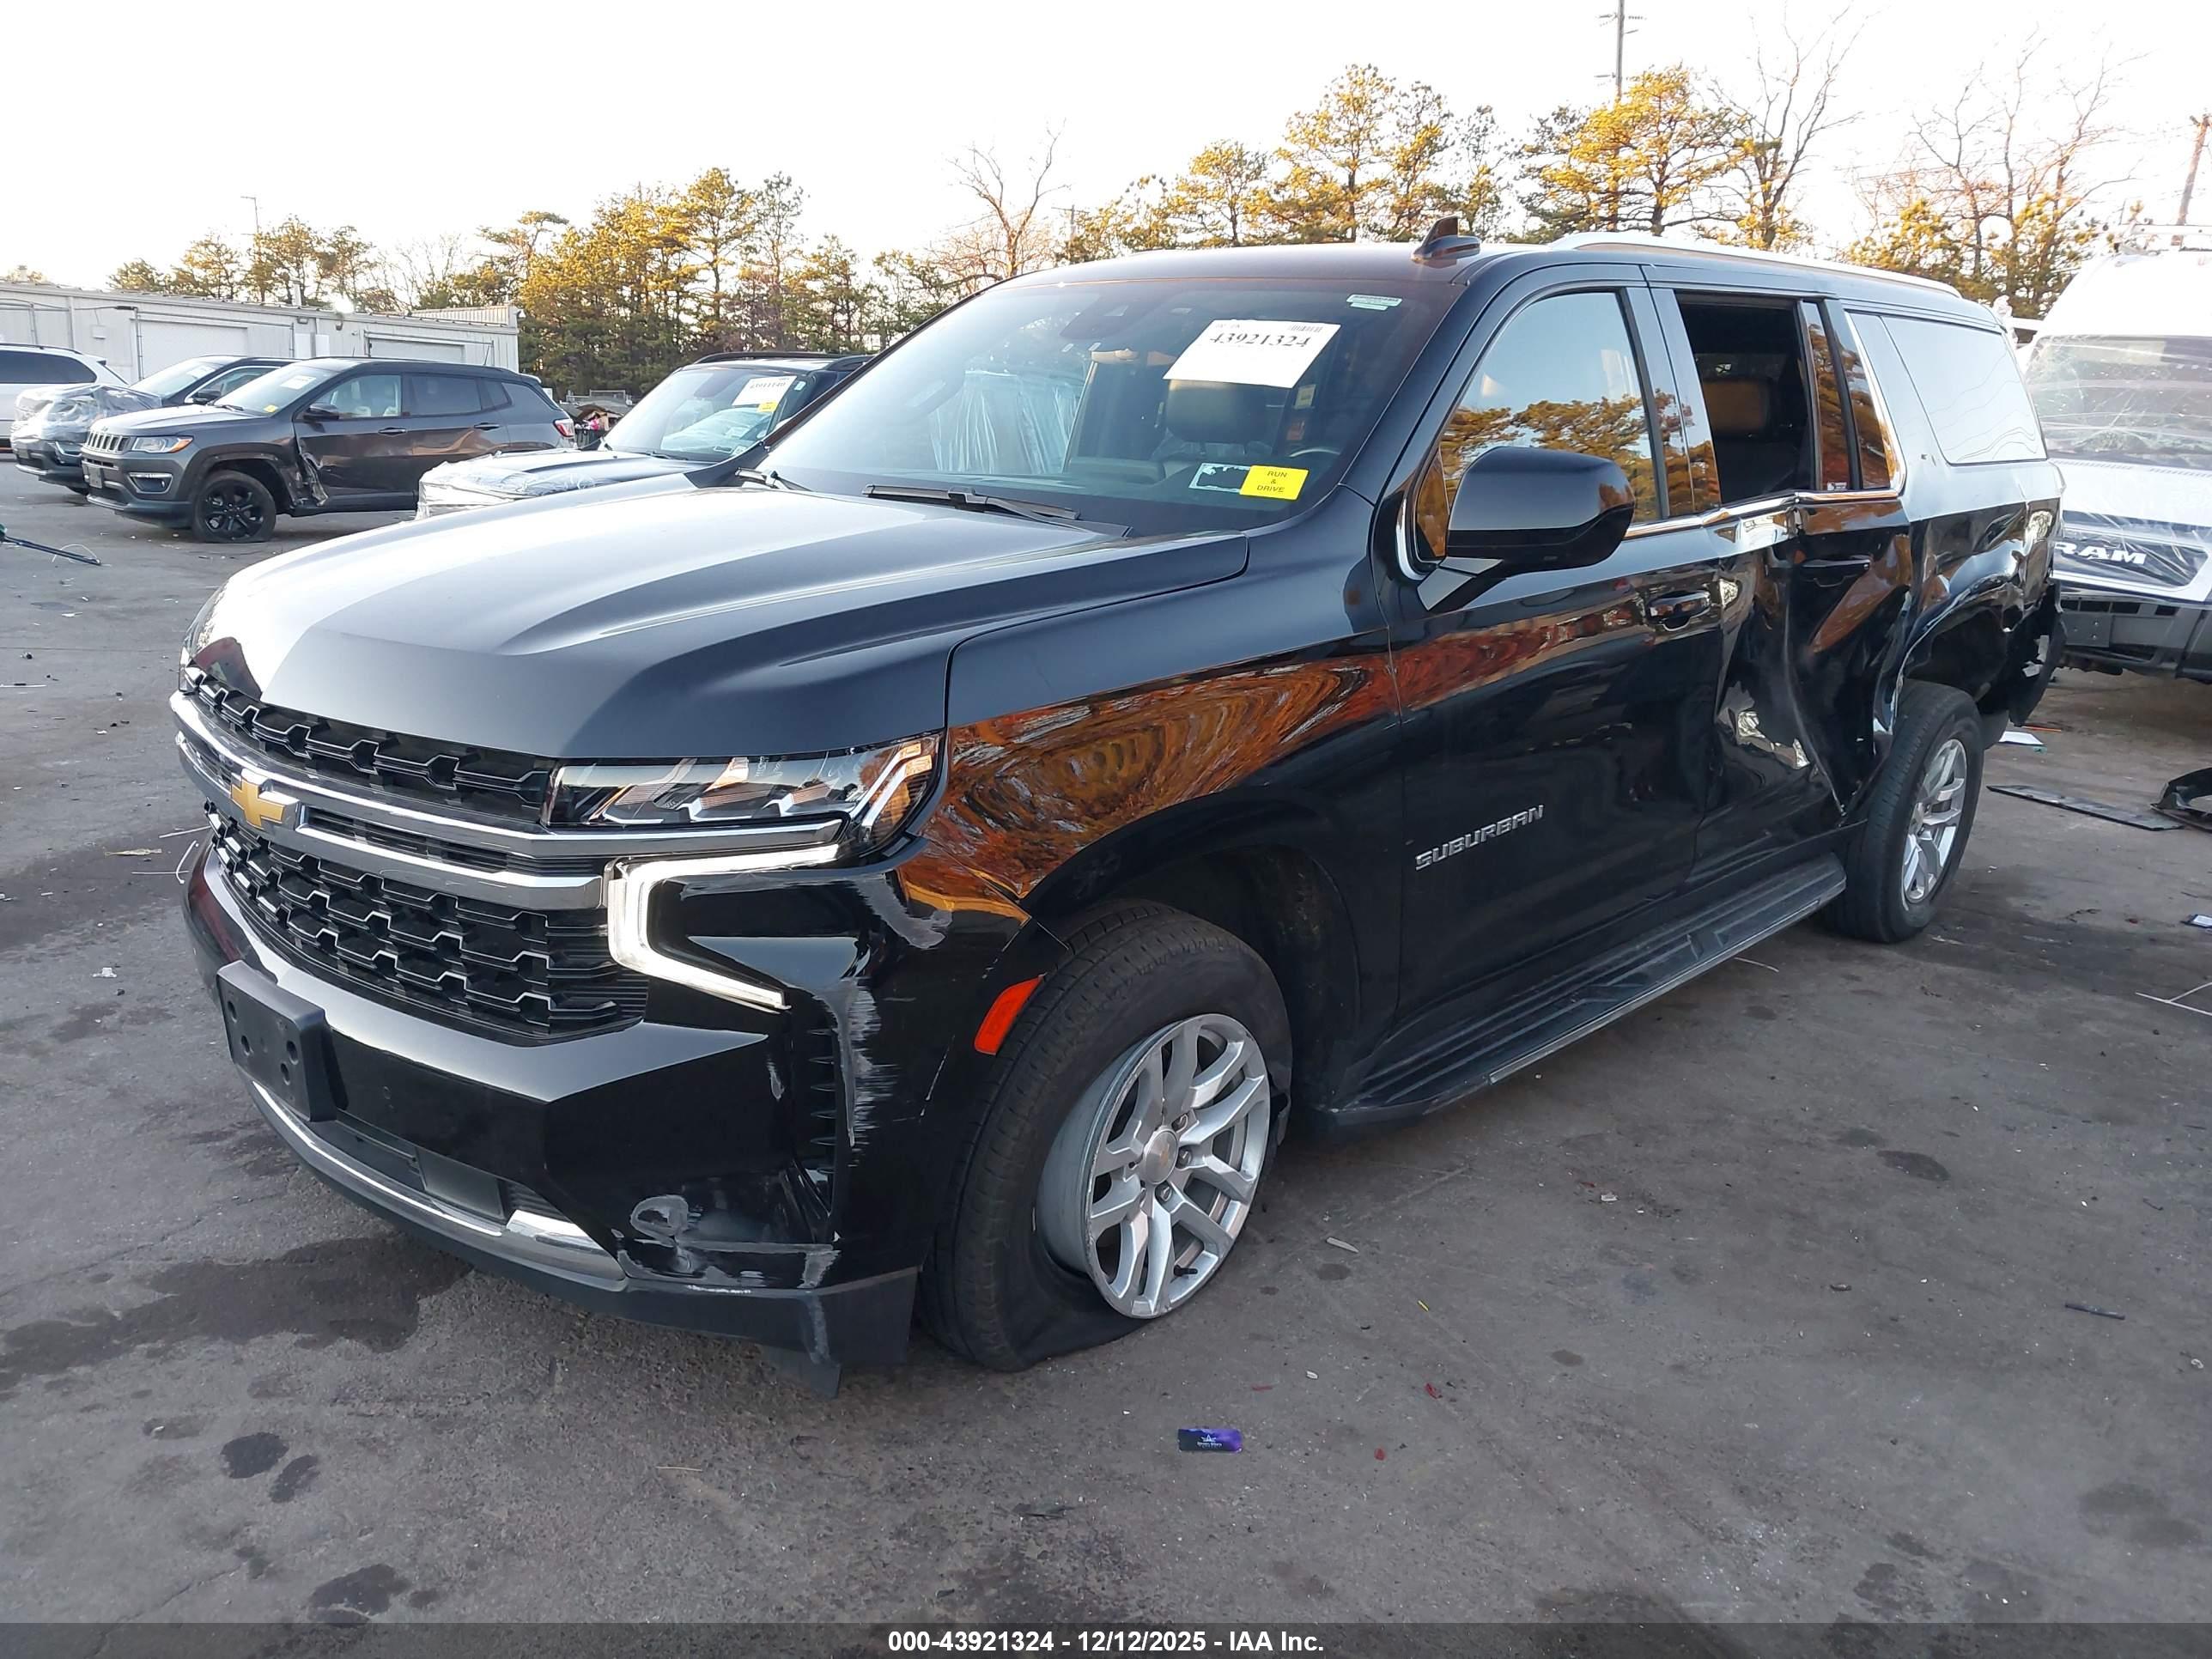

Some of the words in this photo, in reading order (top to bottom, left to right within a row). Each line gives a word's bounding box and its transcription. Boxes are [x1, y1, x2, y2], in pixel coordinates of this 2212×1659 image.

[1210, 332, 1311, 347] 43921324
[1256, 484, 1285, 493] DRIVE
[2054, 542, 2147, 564] RAM
[1414, 805, 1545, 871] SUBURBAN
